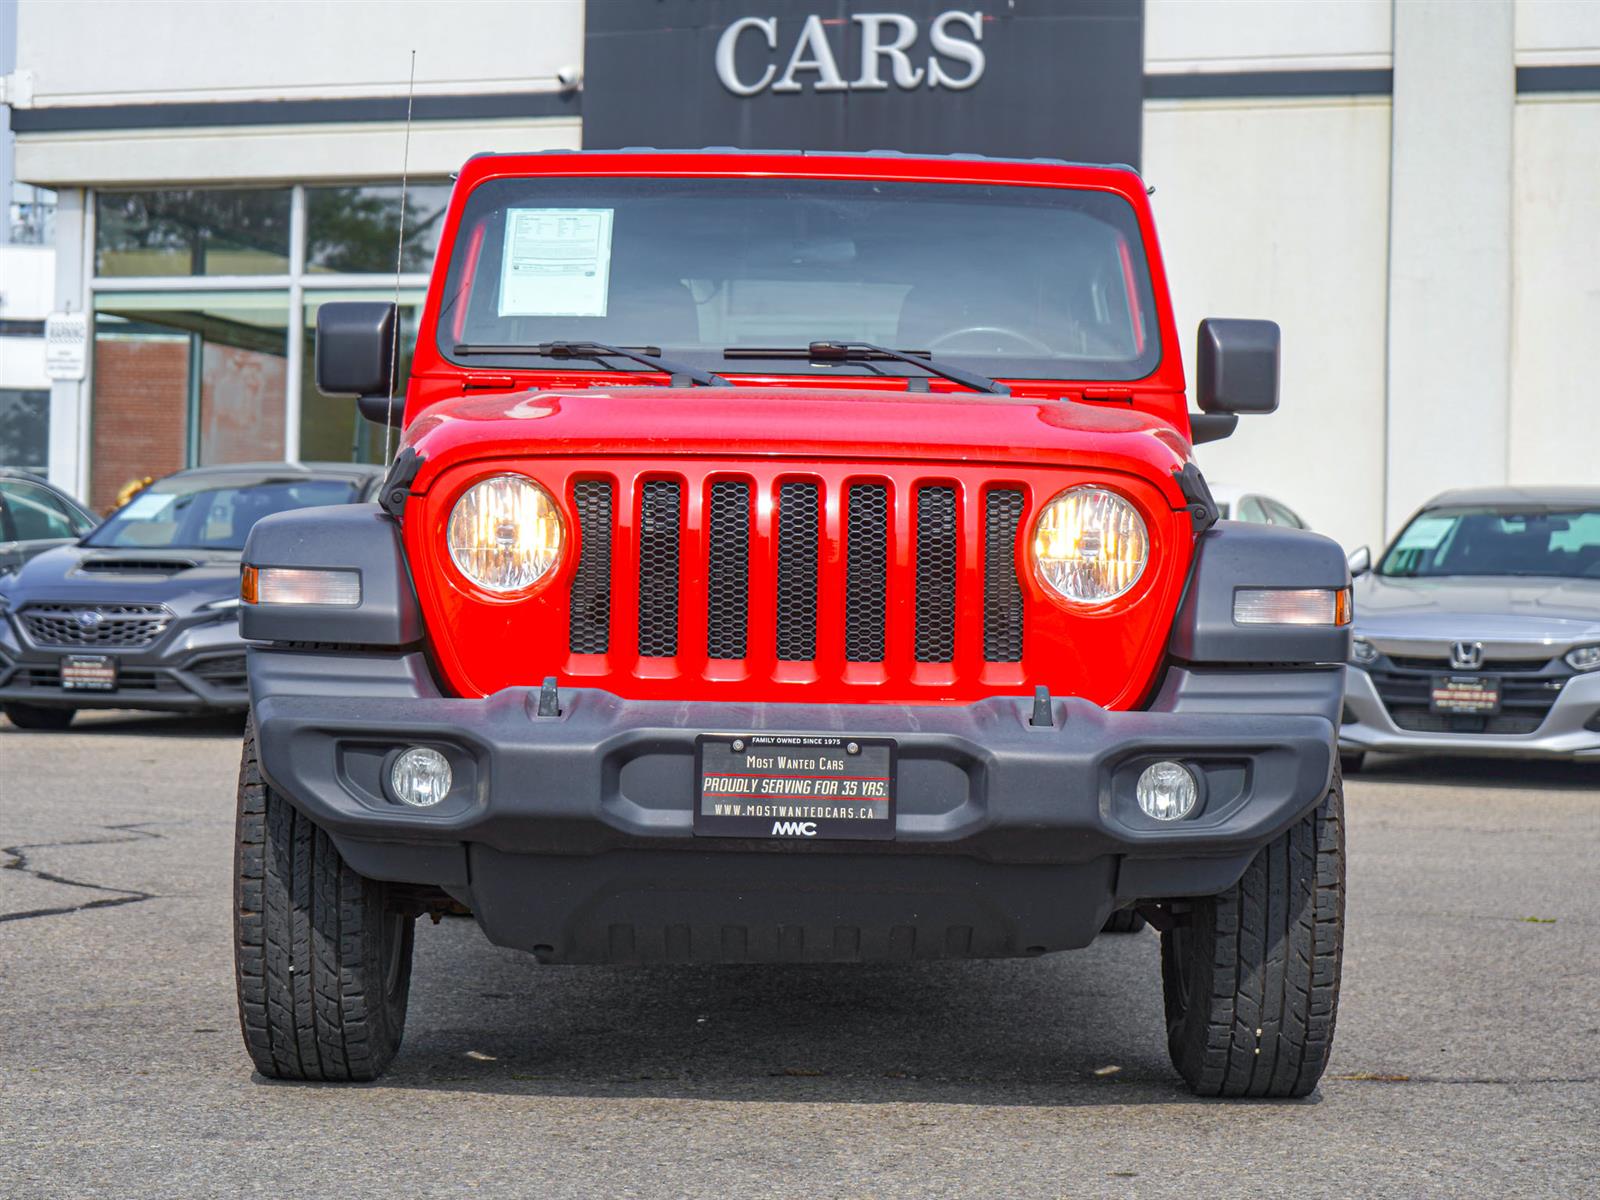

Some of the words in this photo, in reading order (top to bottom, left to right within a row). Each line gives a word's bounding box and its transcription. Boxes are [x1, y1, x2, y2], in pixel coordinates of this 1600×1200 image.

[714, 10, 987, 96] CARS
[703, 777, 759, 793] PROUDLY
[761, 779, 812, 794] SERVING
[814, 780, 838, 795] FOR
[841, 781, 858, 796] 35
[861, 781, 886, 796] YRS.
[714, 804, 874, 819] WWW.MOSTWANTEDCARS.CA
